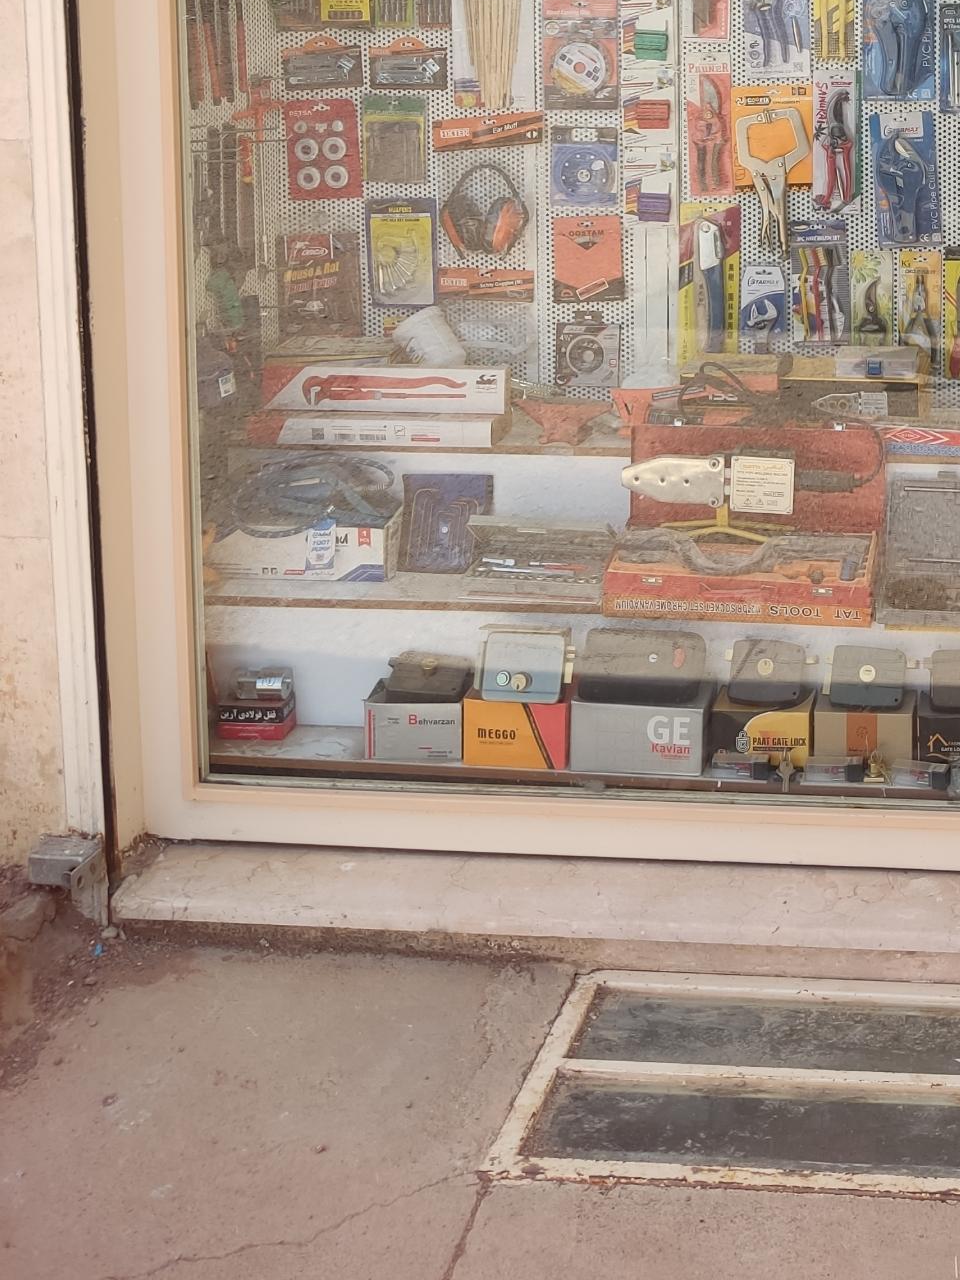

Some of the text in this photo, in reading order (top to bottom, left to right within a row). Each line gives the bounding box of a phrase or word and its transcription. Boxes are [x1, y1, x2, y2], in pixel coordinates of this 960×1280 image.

[769, 605, 822, 618] TOOLS
[834, 607, 862, 620] TAT
[238, 710, 262, 721] فولادی
[263, 710, 277, 720] قفل
[408, 713, 456, 726] Behvarzan
[477, 727, 517, 740] MEGGO
[646, 715, 691, 745] GE
[651, 742, 691, 755] Kavian
[771, 737, 789, 746] GATE
[789, 737, 808, 747] LOCK
